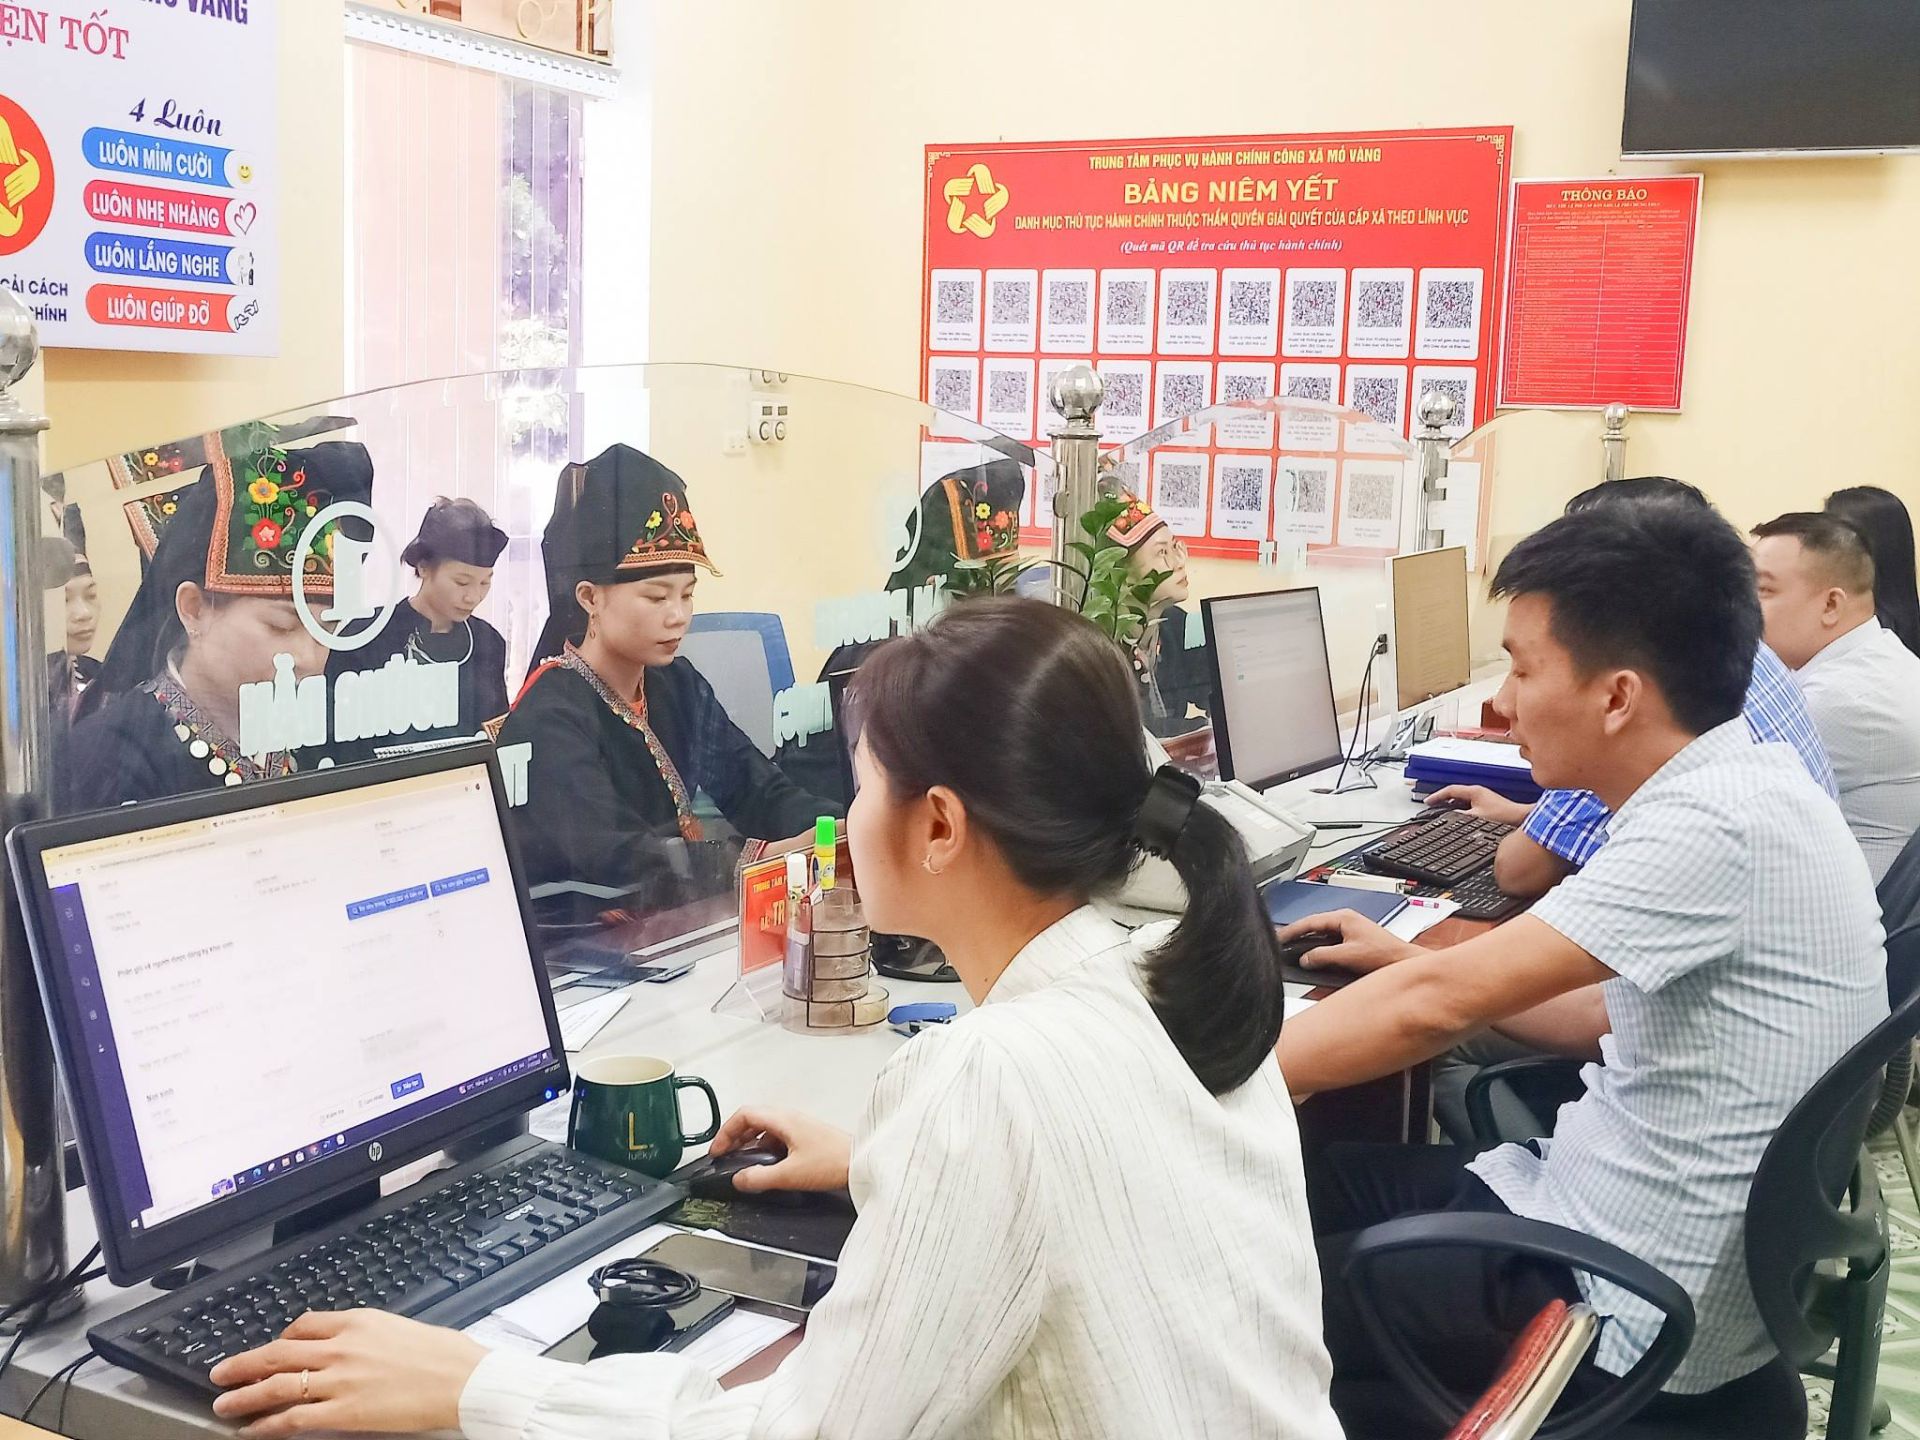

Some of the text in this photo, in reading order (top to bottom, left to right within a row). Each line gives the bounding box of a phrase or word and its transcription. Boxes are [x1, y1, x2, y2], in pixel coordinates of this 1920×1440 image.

[60, 9, 129, 60] TỐT
[129, 98, 223, 137] 4 Luôn
[99, 138, 212, 179] LUÔN MỈM CƯỜI
[1089, 147, 1381, 170] TRUNG TÂM PHỤC VỤ HÀNH CHÍNH CÔNG XÃ MỎ VÀNG
[1124, 172, 1339, 204] BẢNG NIÊM YẾT
[1561, 186, 1647, 202] THÔNG BÁO
[92, 189, 219, 229] LUÔN NHẸ NHÀNG
[1015, 215, 1040, 229] DANH
[1042, 214, 1064, 231] MỤC
[1064, 211, 1082, 229] THỦ
[1085, 214, 1103, 231] TỤC
[1105, 211, 1132, 228] HÀNH
[1134, 210, 1163, 228] CHÍNH
[1167, 211, 1199, 230] THUỘC
[1201, 208, 1229, 227] THẨM
[1266, 207, 1287, 226] GIẢI
[1289, 206, 1323, 228] QUYẾT
[1324, 208, 1346, 225] CỦA
[1348, 206, 1370, 225] CẤP
[1371, 208, 1385, 224] XÃ
[1387, 209, 1415, 225] THEO
[1418, 207, 1443, 224] LĨNH
[1446, 208, 1469, 227] VỰC
[95, 239, 219, 278] LUÔN LẮNG NGHE
[1120, 240, 1147, 253] (Quét
[1168, 240, 1184, 252] QR
[1201, 241, 1216, 251] tra
[1259, 240, 1276, 252] tục
[1278, 239, 1305, 251] hành
[1307, 239, 1343, 251] chính)
[29, 277, 68, 297] CÁCH
[29, 303, 67, 322] HÍNH
[107, 293, 211, 326] LUÔN GIÚP ĐỠ
[369, 1141, 383, 1162] hp
